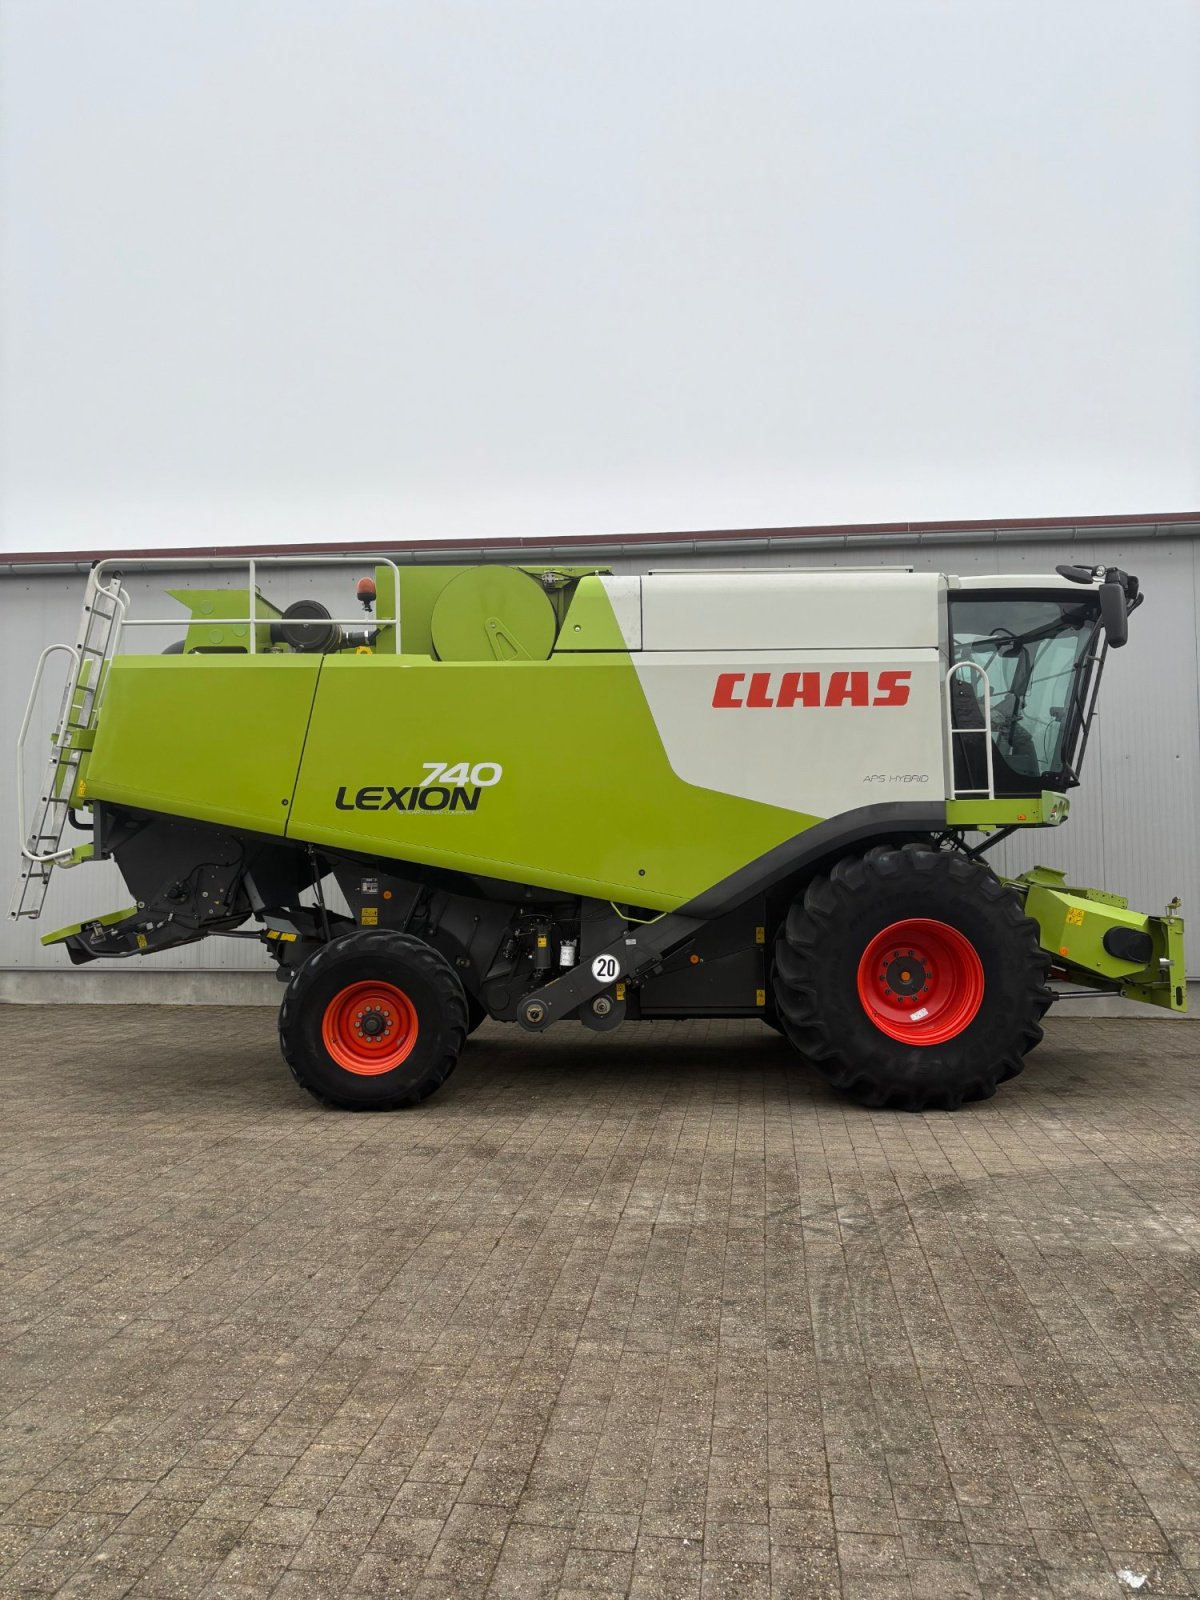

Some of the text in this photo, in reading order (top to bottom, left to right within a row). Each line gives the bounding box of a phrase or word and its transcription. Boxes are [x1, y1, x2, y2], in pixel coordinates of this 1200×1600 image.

[712, 671, 912, 708] CLAAS
[419, 762, 503, 787] 740
[863, 774, 929, 783] APS HYBRID
[335, 786, 482, 811] LEXION
[597, 958, 615, 977] 20
